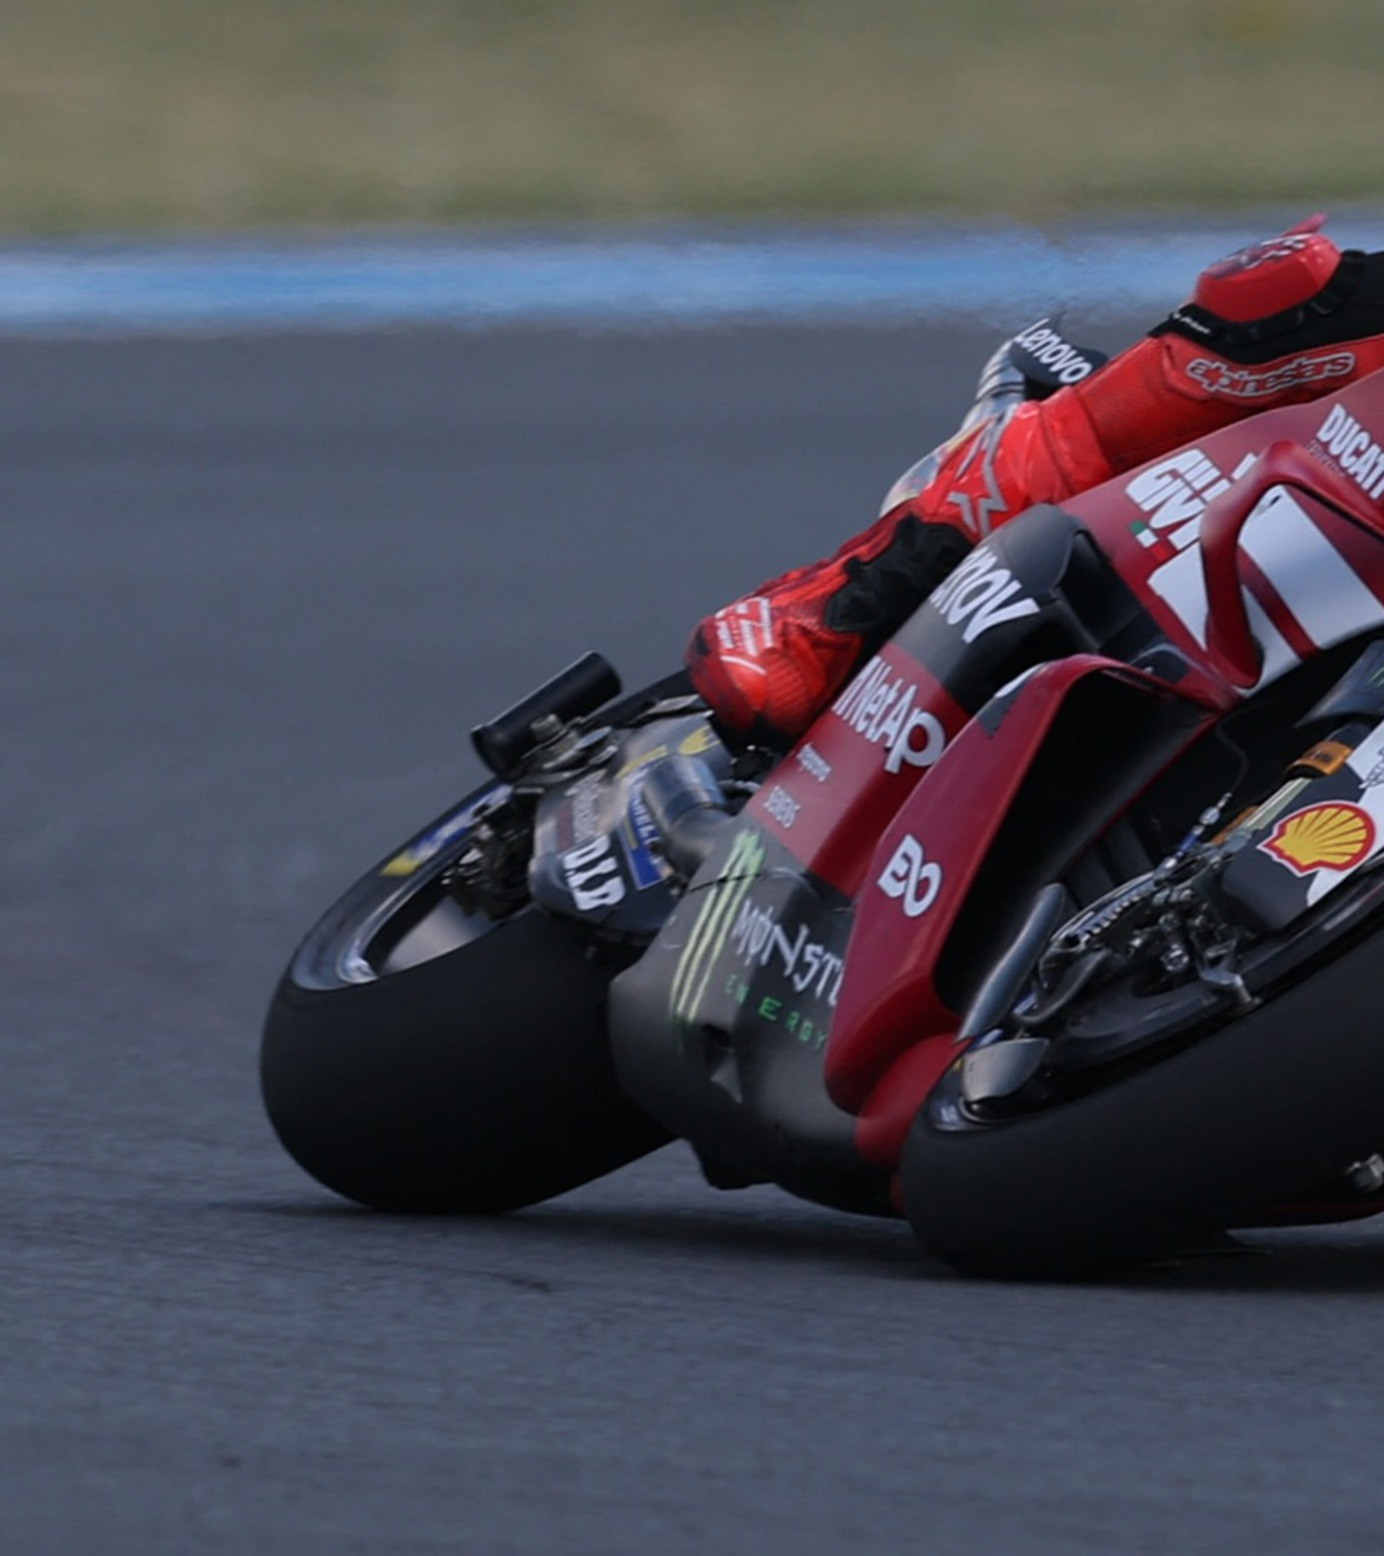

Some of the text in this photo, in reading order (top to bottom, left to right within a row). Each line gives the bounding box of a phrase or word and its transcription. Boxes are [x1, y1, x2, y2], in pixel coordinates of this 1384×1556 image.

[1013, 317, 1092, 383] Lenovo
[840, 656, 946, 774] NetAp
[731, 898, 846, 1007] MONST
